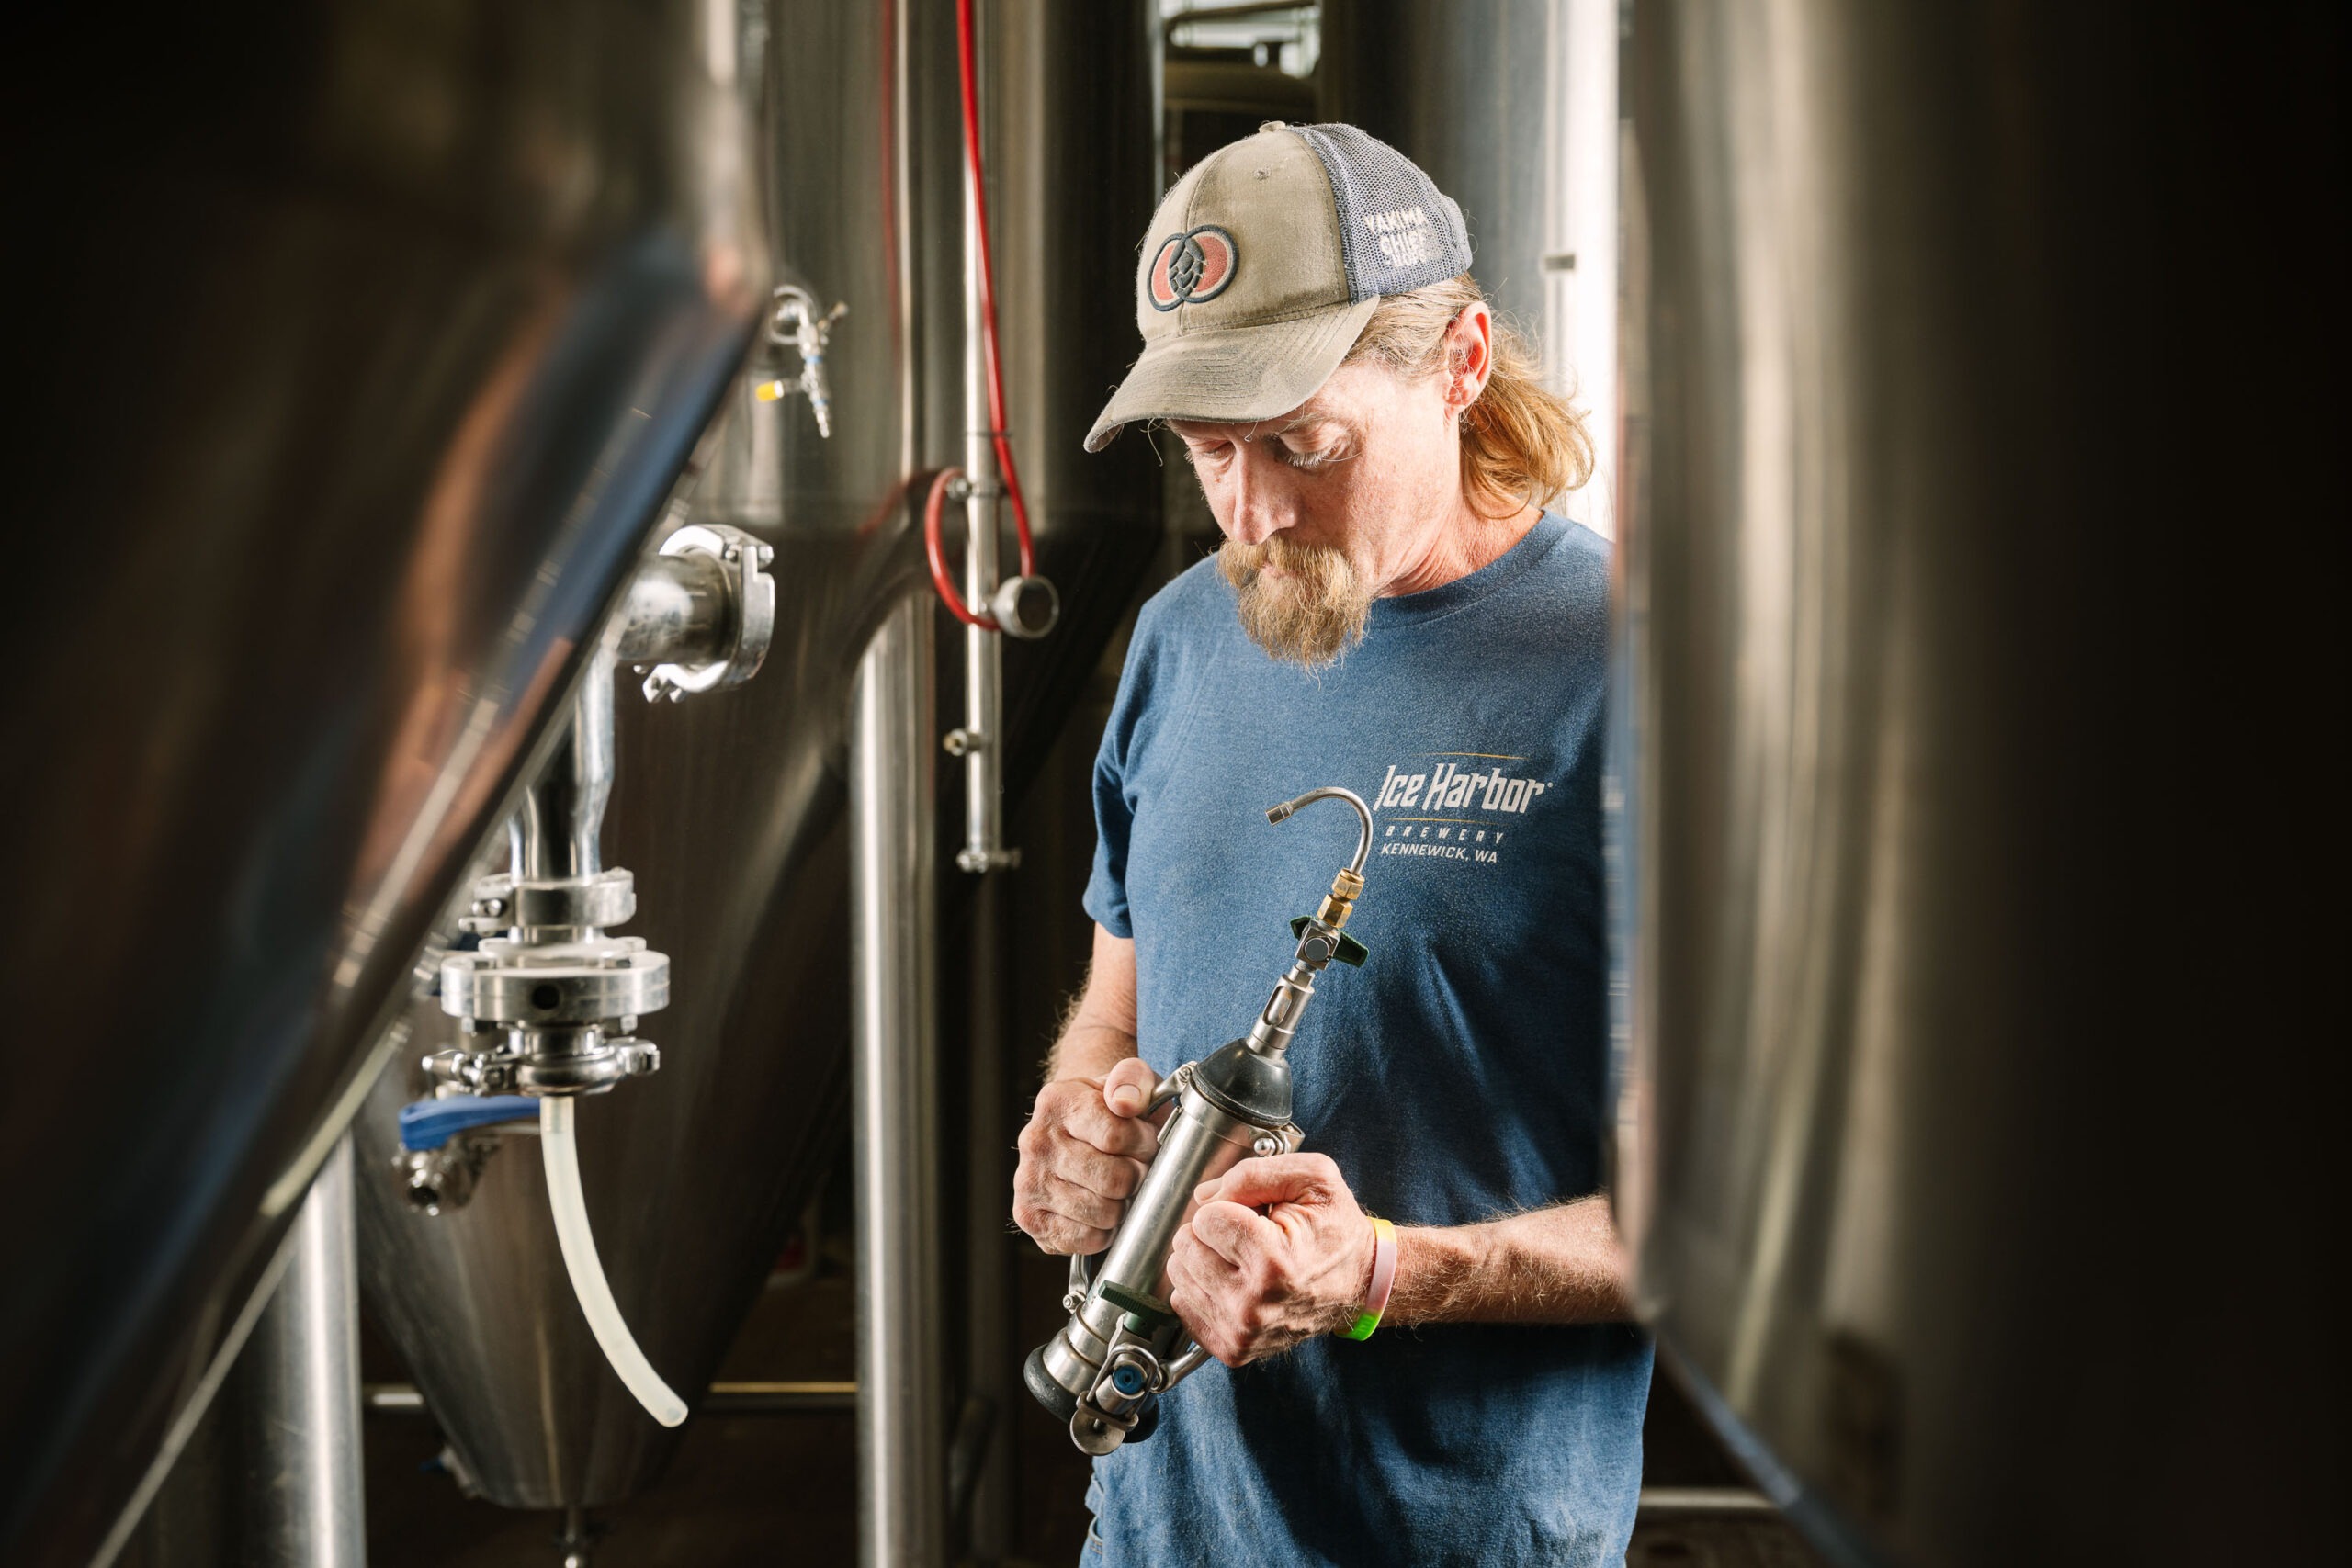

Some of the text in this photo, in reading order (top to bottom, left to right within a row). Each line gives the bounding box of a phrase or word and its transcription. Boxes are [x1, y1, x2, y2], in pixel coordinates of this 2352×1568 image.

[1363, 205, 1430, 234] YAKIMA
[1379, 228, 1427, 256] CHIEF
[1373, 762, 1545, 814] Ice Harbor
[1385, 825, 1504, 844] BREWERY
[1381, 843, 1498, 863] KENNEWICK, WA
